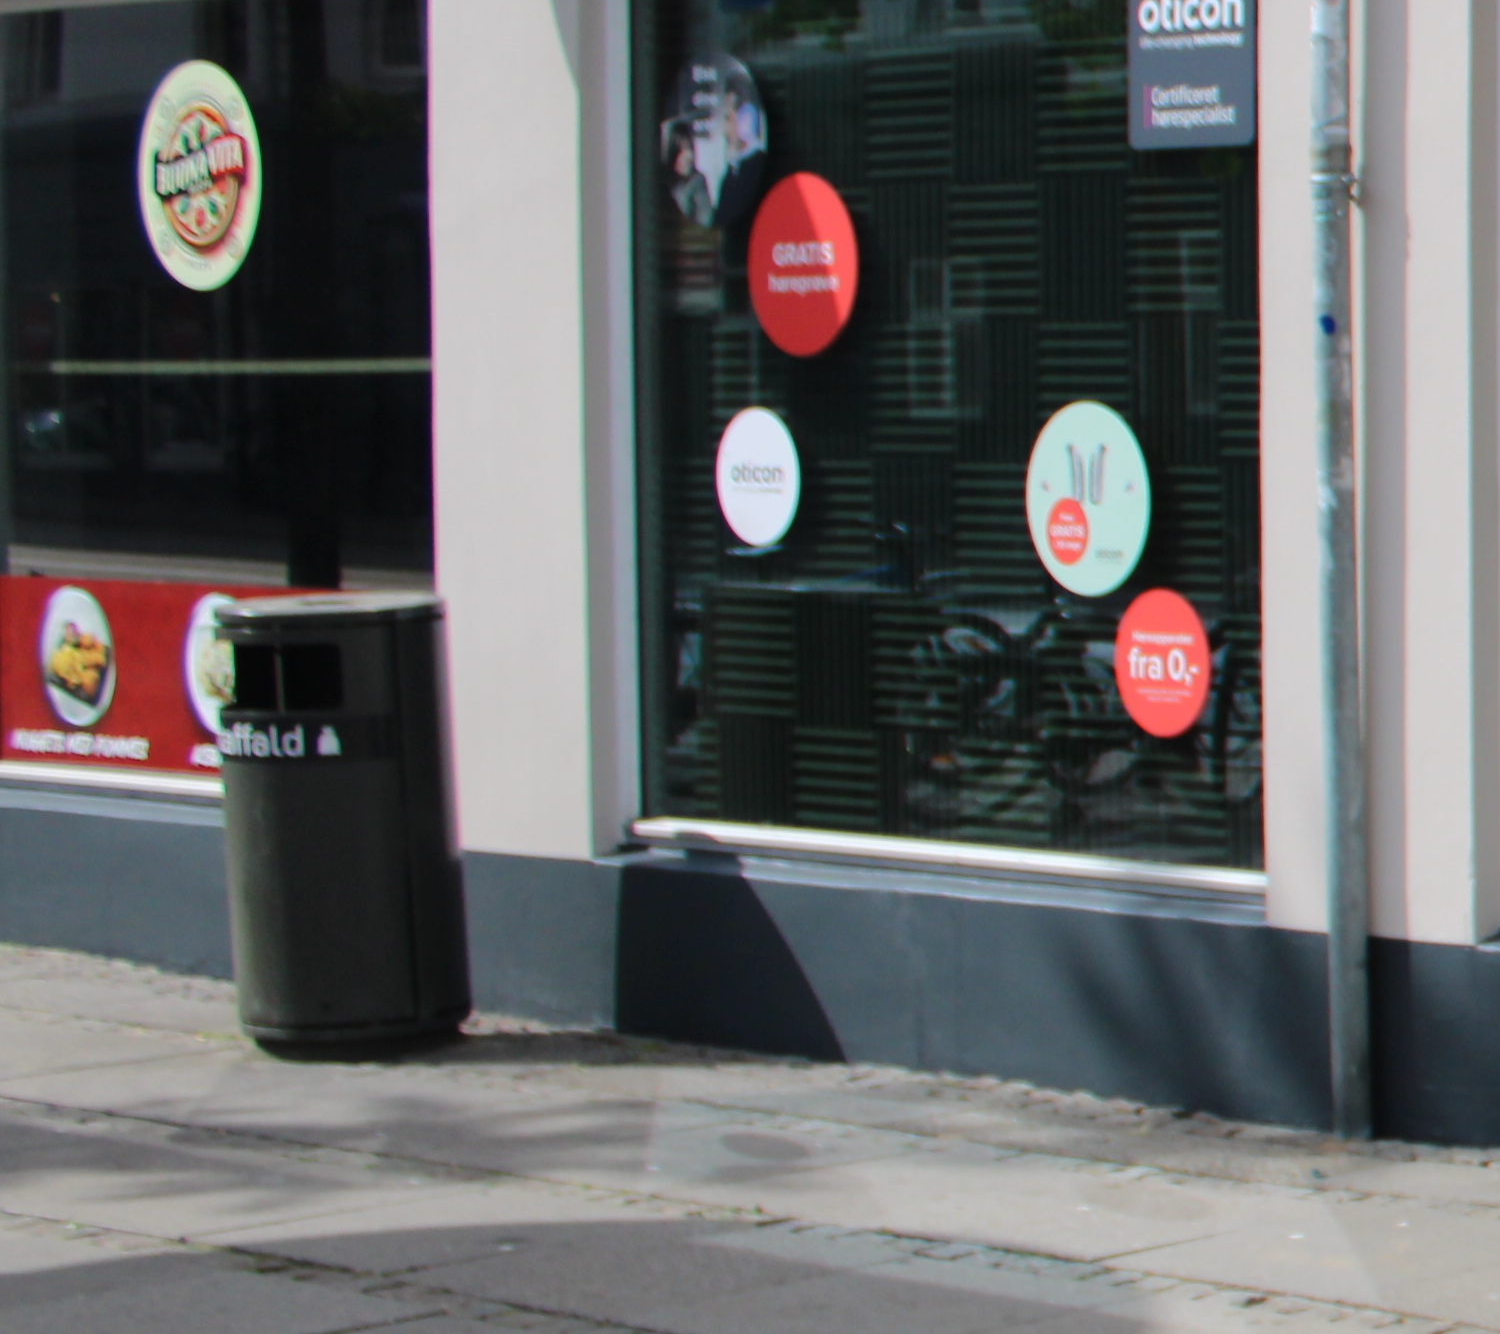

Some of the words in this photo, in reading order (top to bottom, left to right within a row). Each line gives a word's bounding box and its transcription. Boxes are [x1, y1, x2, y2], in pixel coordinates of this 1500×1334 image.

[1151, 85, 1221, 107] Certificeret
[772, 242, 836, 267] GRATIS
[730, 460, 785, 483] oticon
[1127, 647, 1164, 681] fra
[1167, 648, 1200, 687] 0,-
[217, 723, 305, 757] affald
